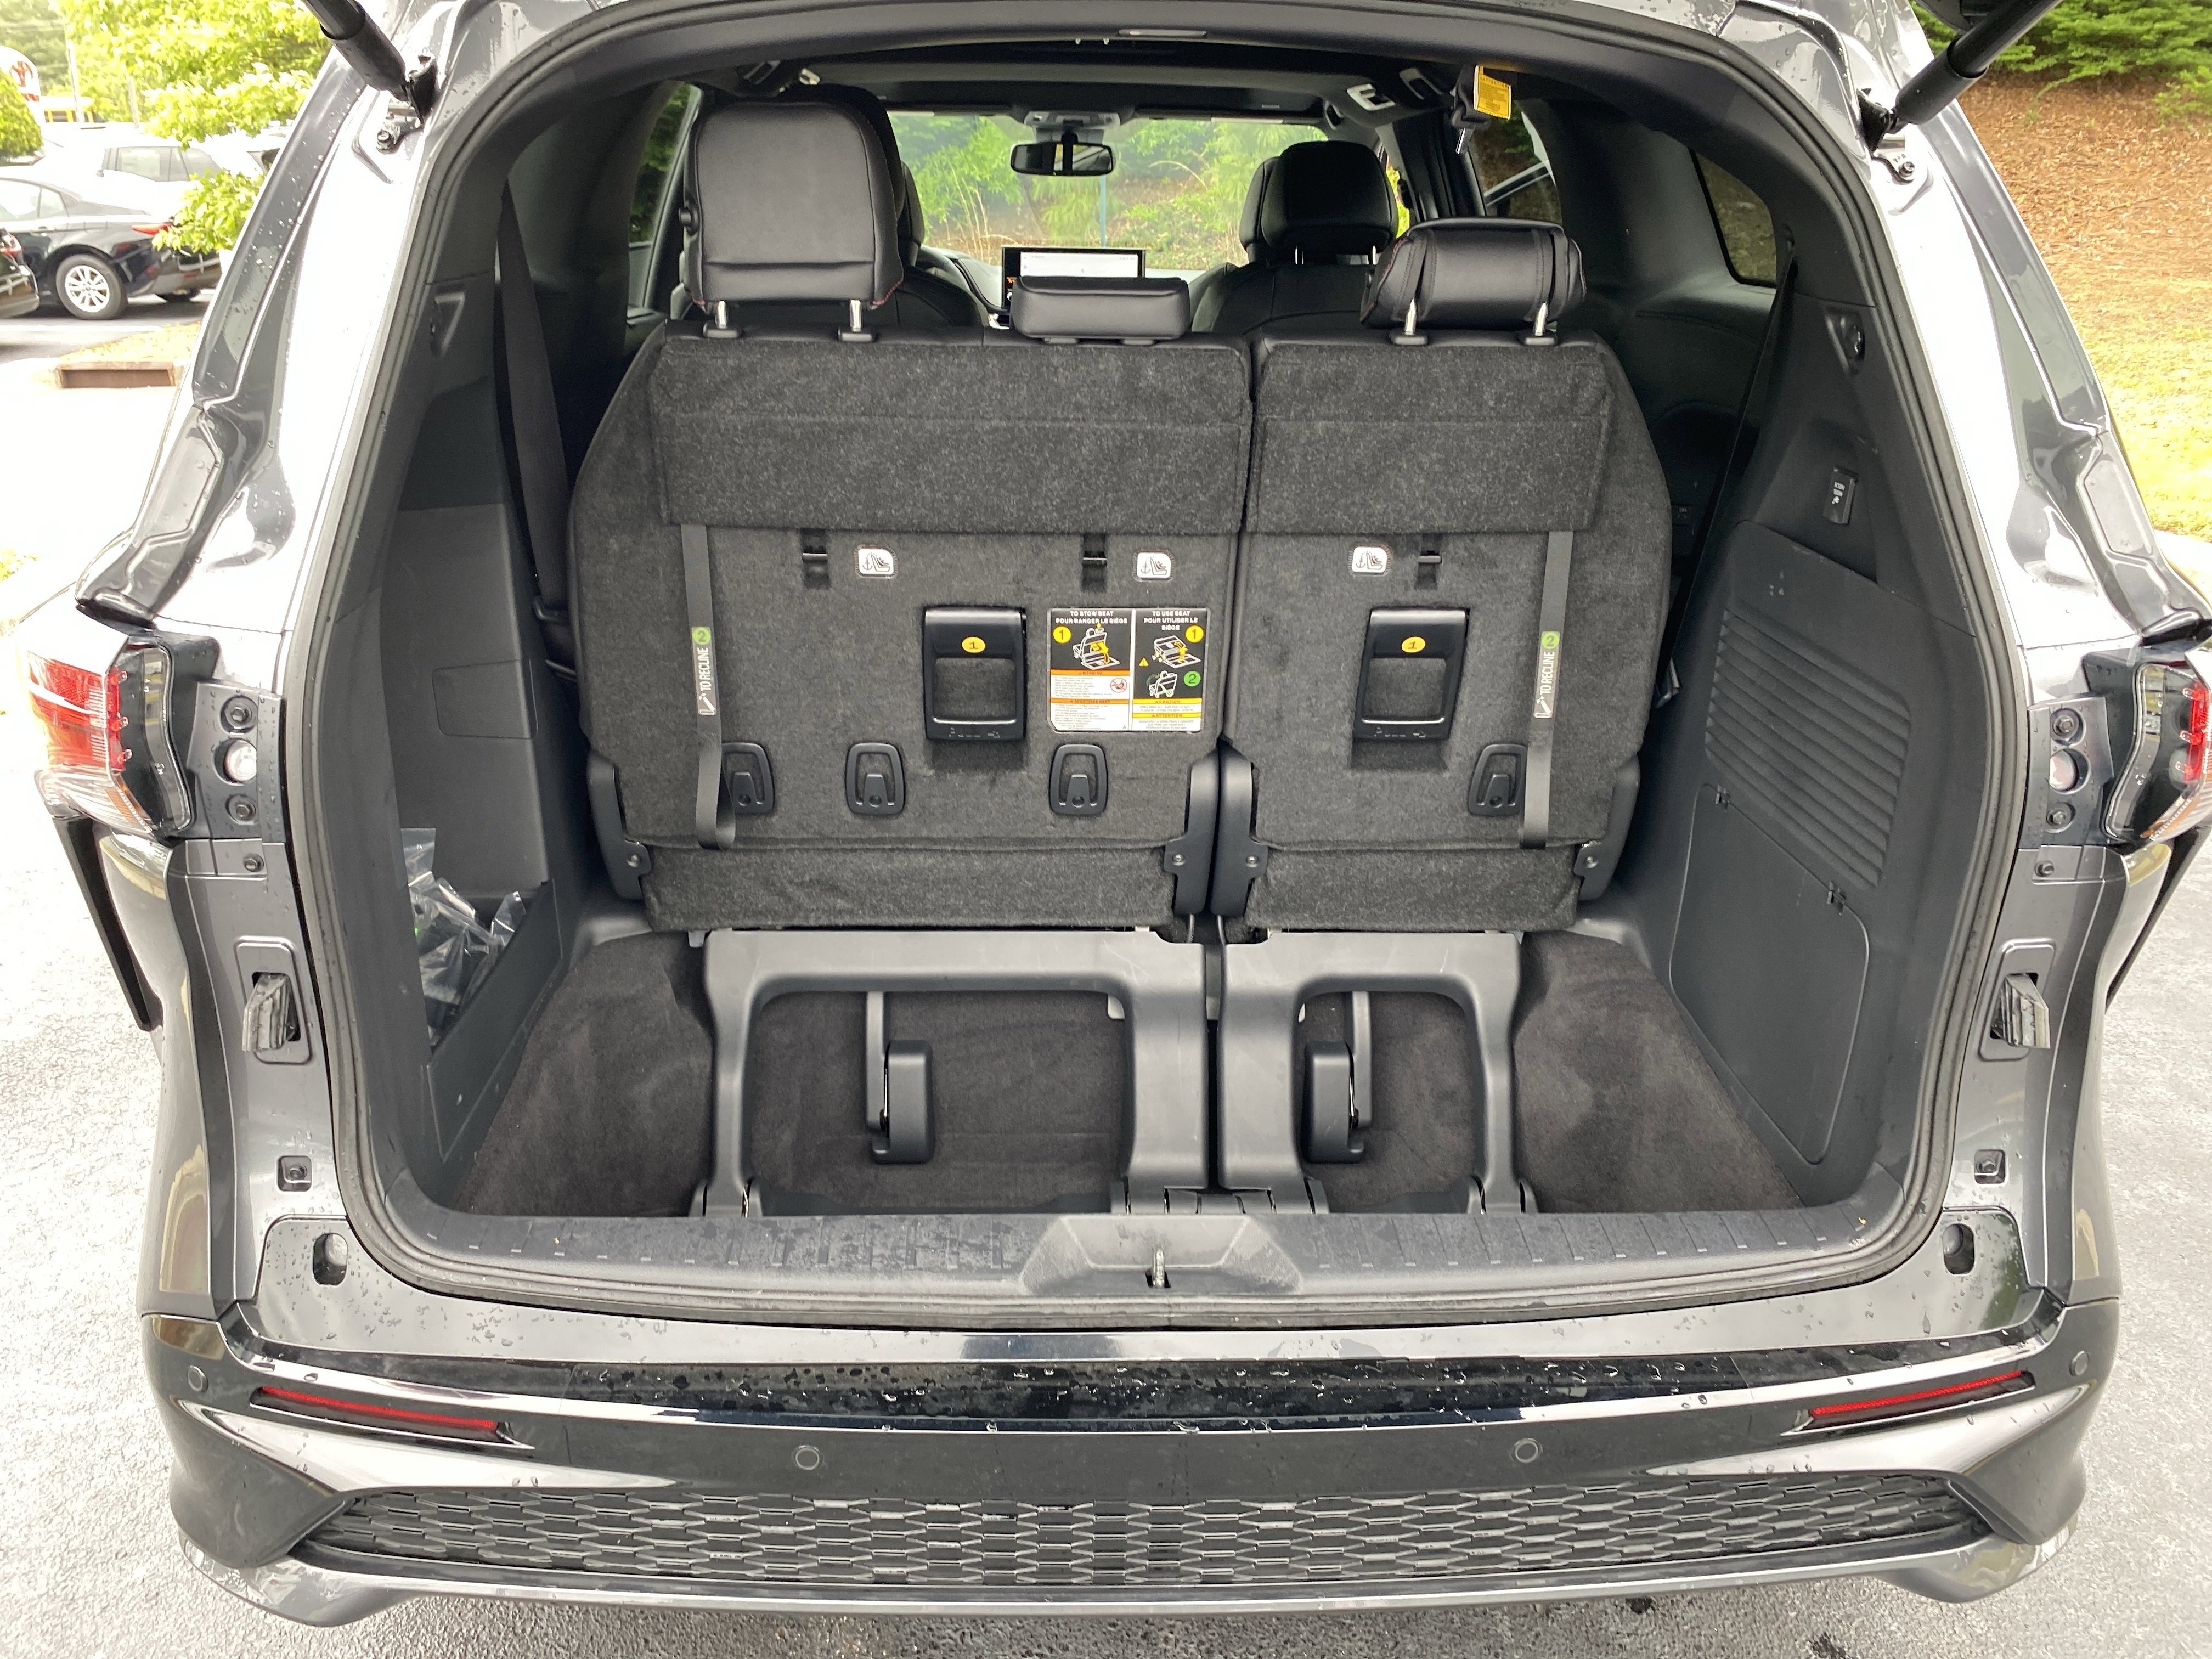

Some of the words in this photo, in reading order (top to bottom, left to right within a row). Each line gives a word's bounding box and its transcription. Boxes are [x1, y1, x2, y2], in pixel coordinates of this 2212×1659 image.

[698, 630, 706, 642] 2
[1059, 629, 1063, 640] 1
[1192, 628, 1196, 640] 1
[969, 641, 978, 650] 1
[1408, 641, 1417, 650] 1
[1547, 635, 1554, 646] 2
[697, 647, 710, 680] RECLINE
[1541, 651, 1555, 684] RECLINE
[1188, 674, 1196, 684] 2
[699, 681, 712, 691] TO
[1540, 685, 1552, 695] TO
